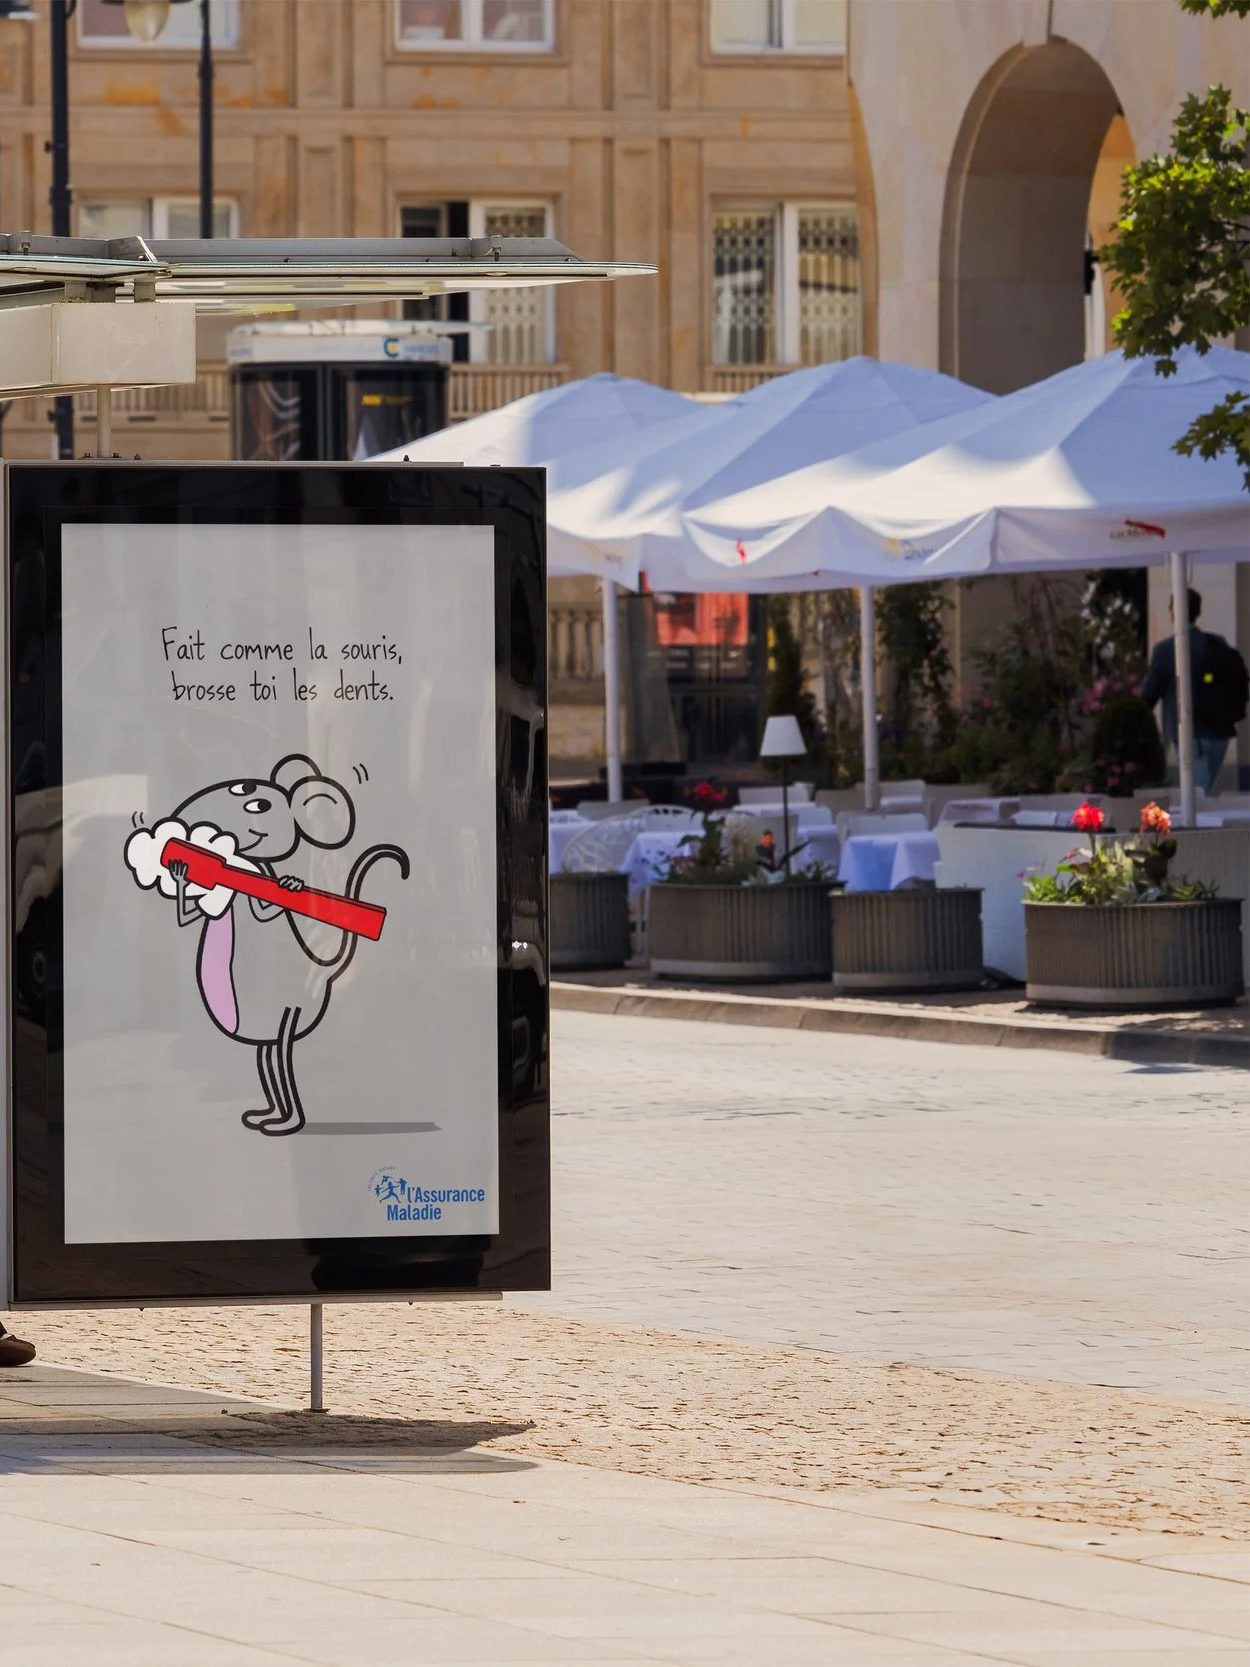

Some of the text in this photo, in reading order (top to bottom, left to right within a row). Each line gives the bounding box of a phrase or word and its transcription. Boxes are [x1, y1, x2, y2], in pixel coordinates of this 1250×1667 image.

[161, 626, 402, 665] Fait comme la souris,
[171, 667, 394, 701] brosse toi les dents.
[407, 1186, 486, 1203] l'Assurance
[387, 1204, 442, 1221] Maladie
